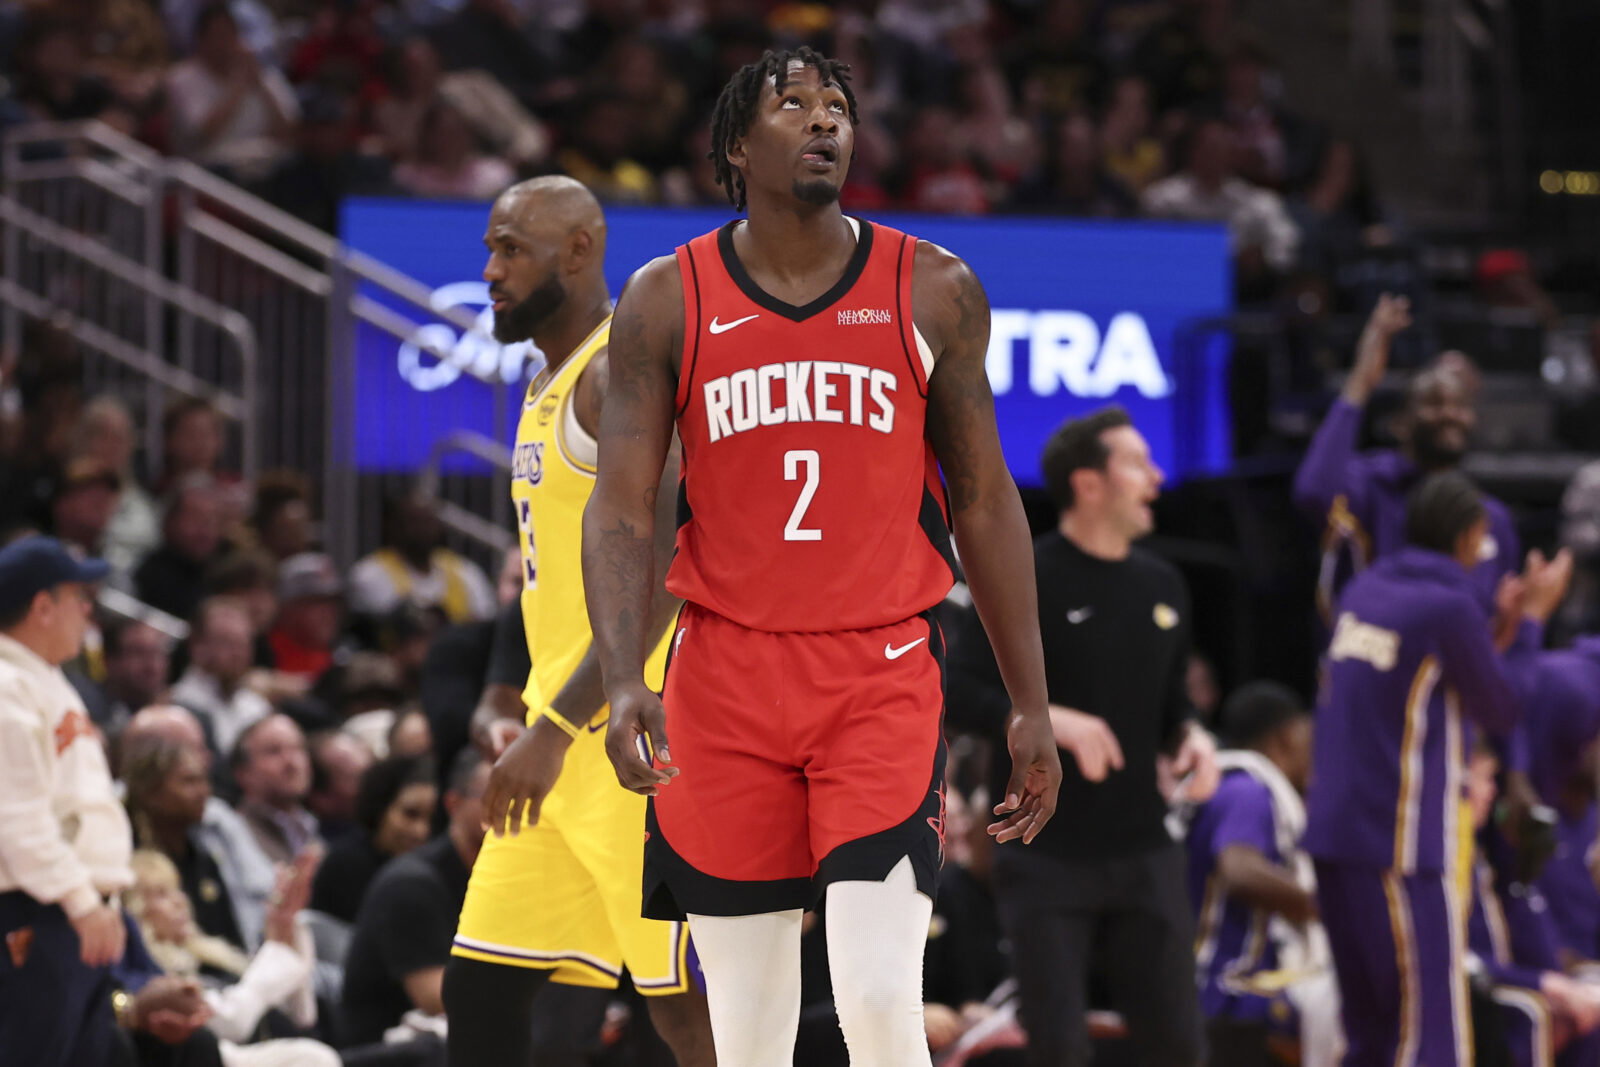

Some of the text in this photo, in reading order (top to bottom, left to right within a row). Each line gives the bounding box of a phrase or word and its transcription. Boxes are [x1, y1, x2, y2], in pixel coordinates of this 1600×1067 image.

[837, 308, 891, 319] MEMORIAL
[837, 315, 892, 325] HERMANN
[703, 360, 897, 443] ROCKETS
[784, 450, 822, 540] 2
